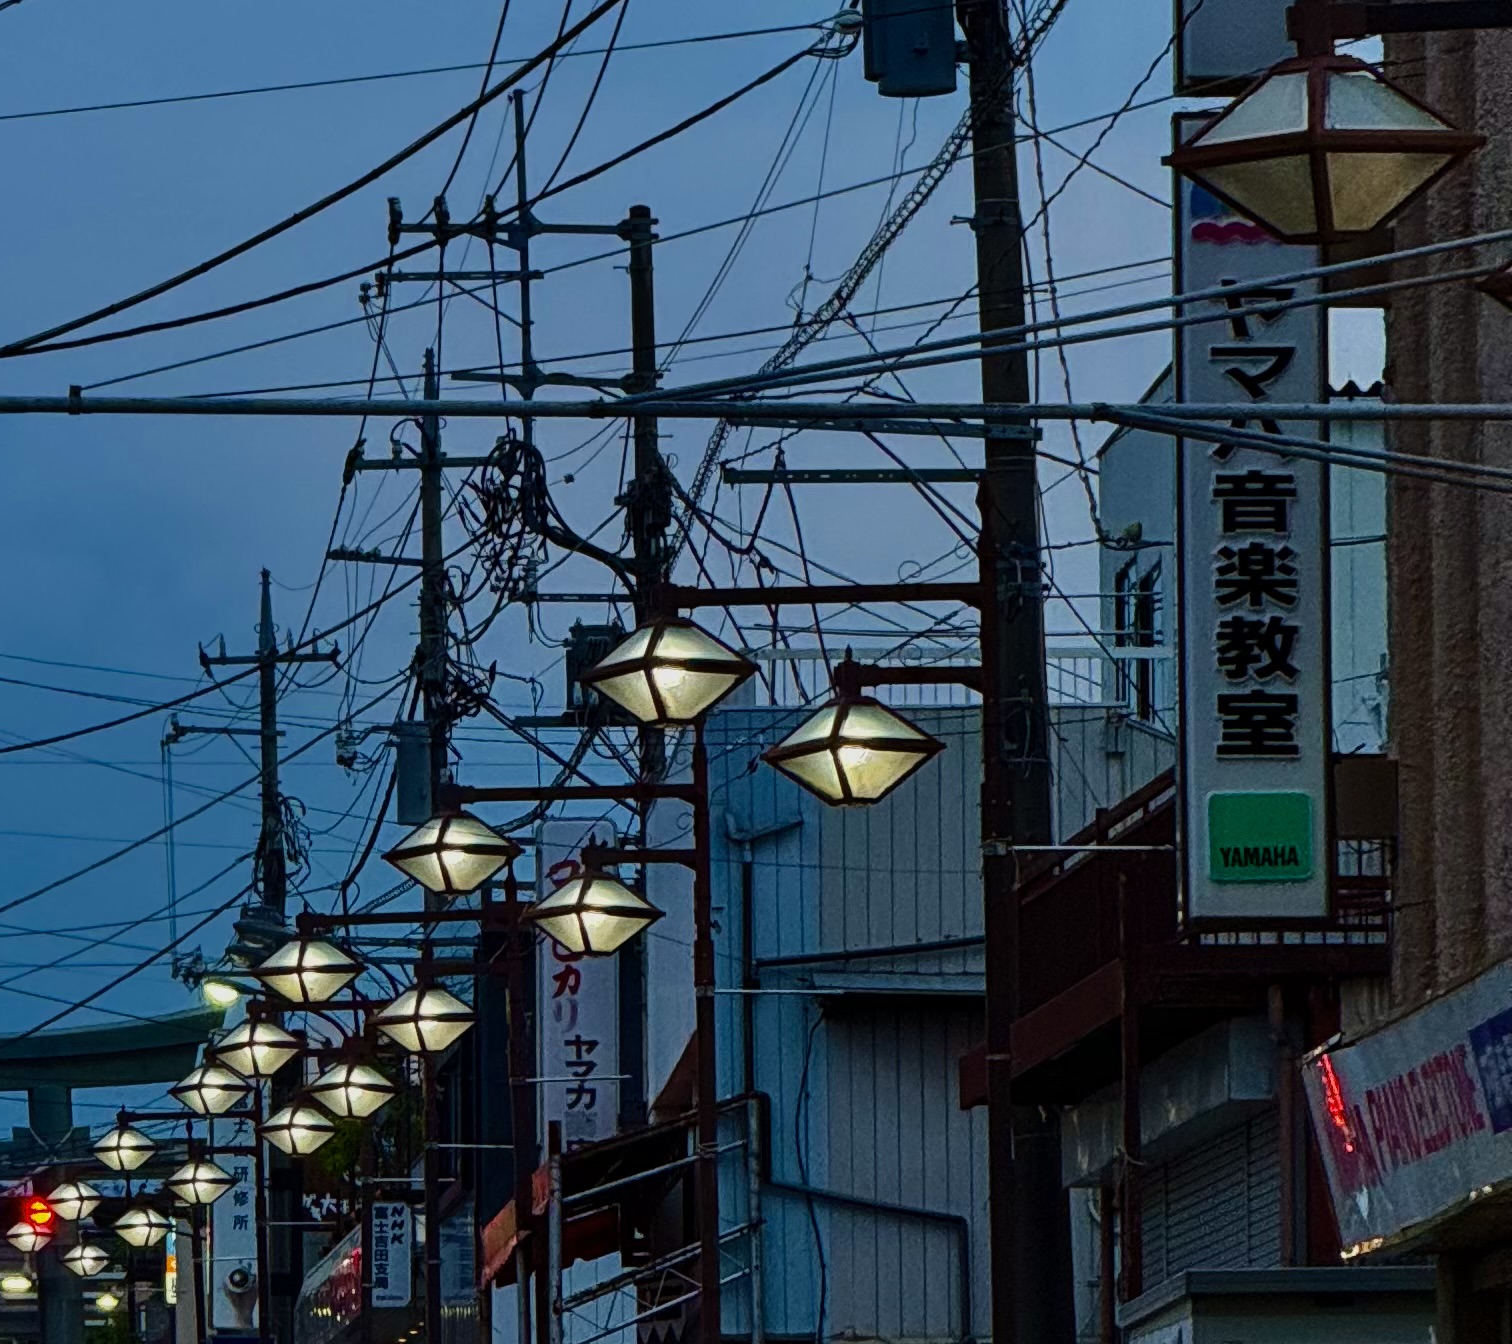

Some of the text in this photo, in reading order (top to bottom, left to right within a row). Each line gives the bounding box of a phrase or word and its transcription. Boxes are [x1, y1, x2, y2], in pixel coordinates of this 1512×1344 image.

[1219, 844, 1300, 869] YAMAHA
[390, 1205, 405, 1245] NHK
[373, 1206, 389, 1290] 富士吉田支局
